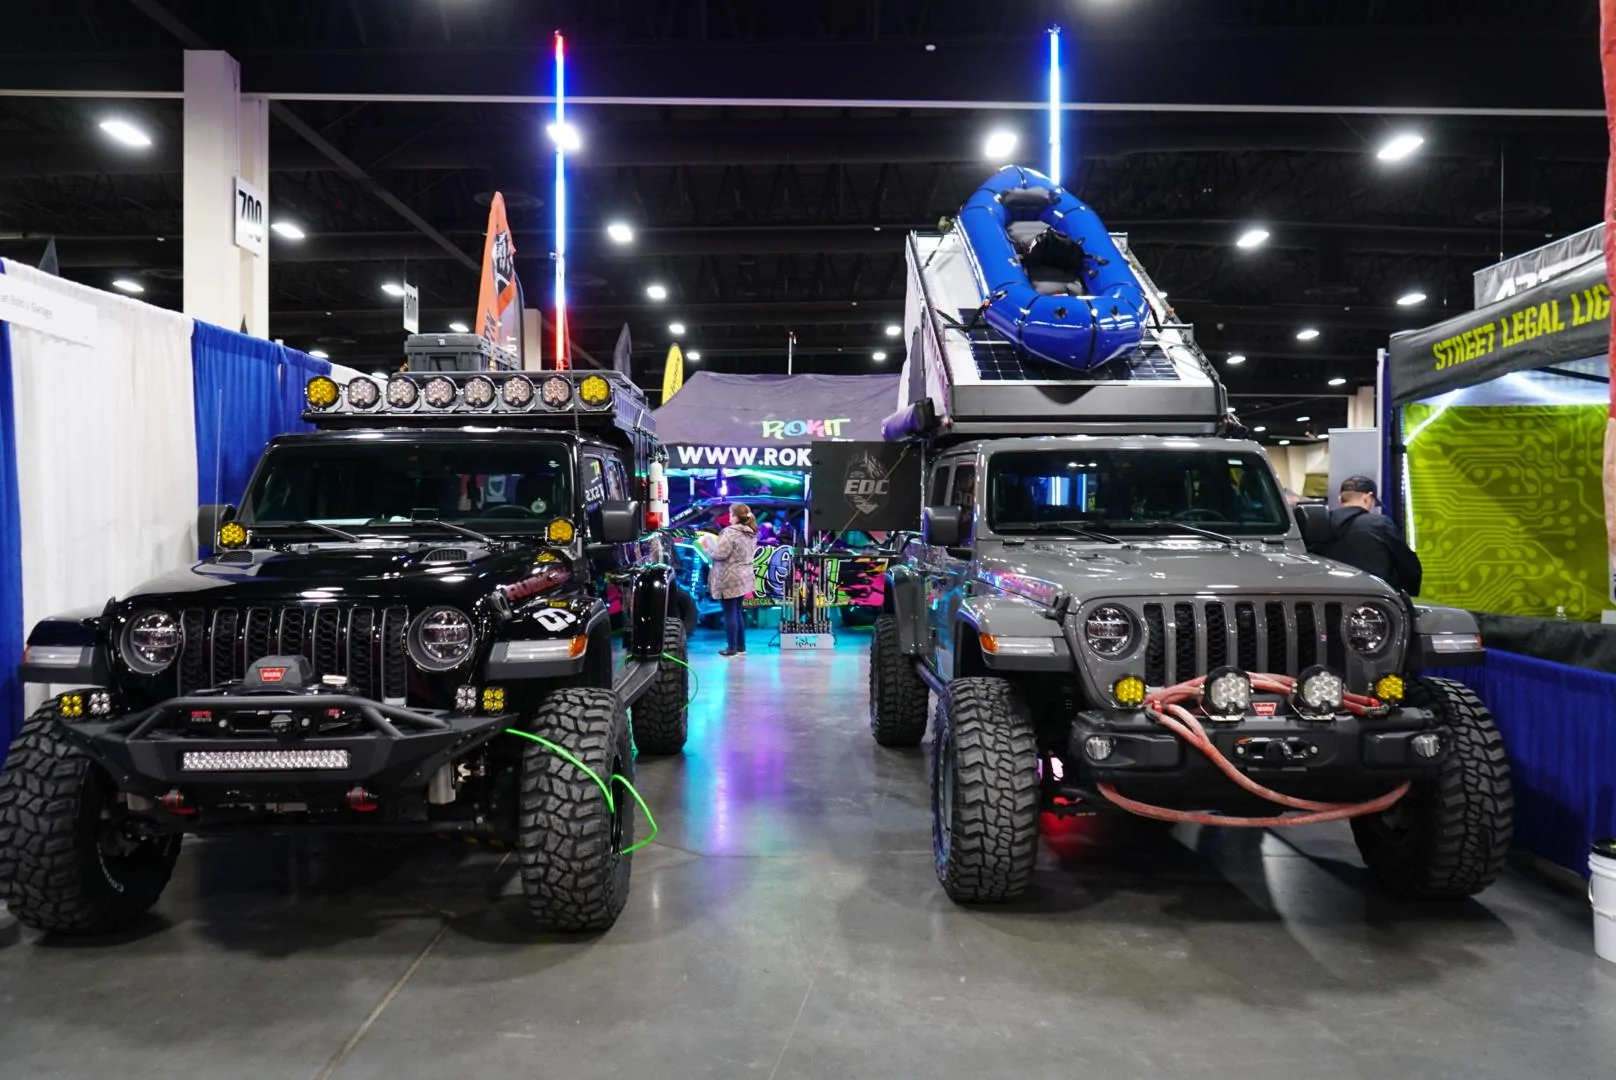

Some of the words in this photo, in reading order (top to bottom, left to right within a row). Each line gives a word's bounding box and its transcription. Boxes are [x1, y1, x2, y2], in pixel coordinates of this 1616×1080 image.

[237, 188, 263, 243] 700
[1432, 322, 1496, 371] STREET
[1501, 299, 1565, 348] LEGAL
[762, 418, 851, 440] ROKIT
[676, 445, 813, 467] WWW.ROK
[844, 479, 890, 495] EDC
